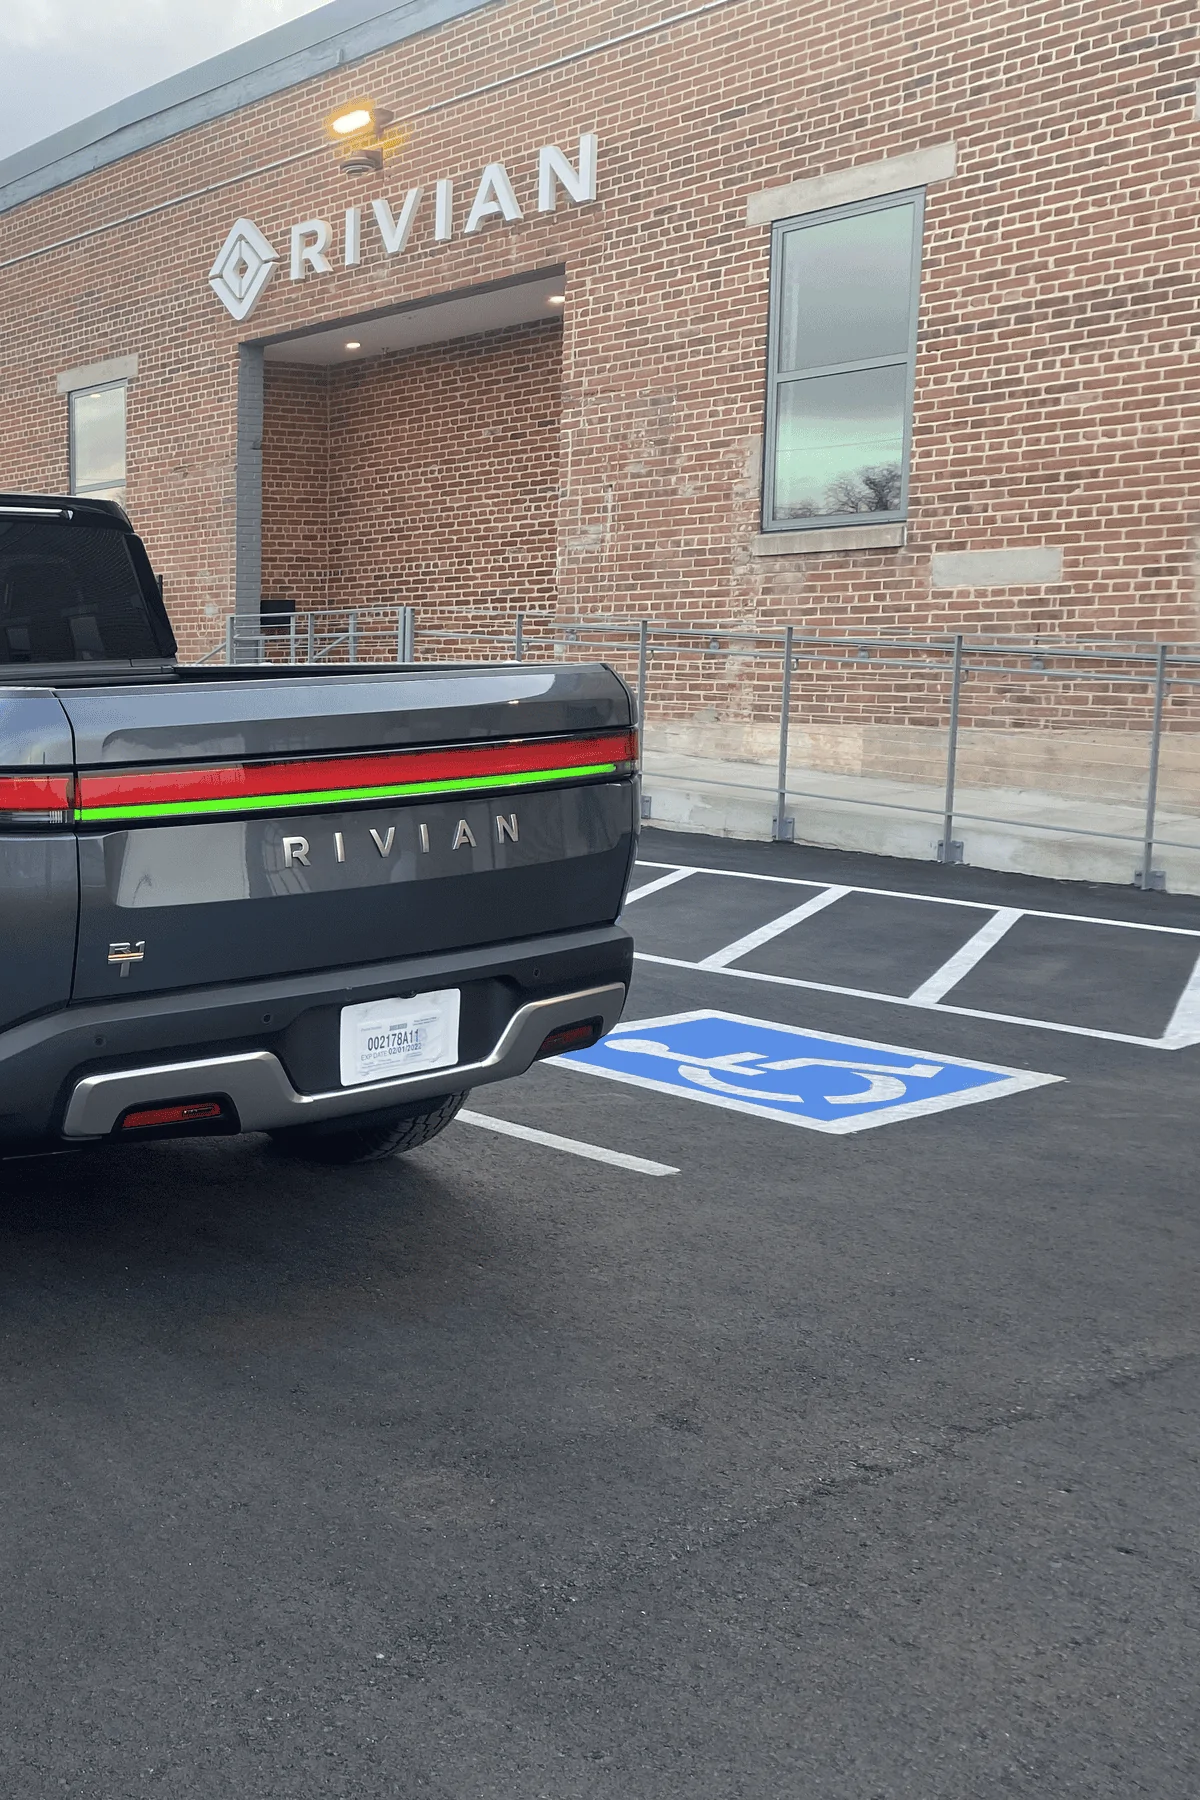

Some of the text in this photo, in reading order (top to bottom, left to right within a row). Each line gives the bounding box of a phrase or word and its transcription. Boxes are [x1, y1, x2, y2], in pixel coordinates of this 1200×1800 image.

[290, 133, 599, 281] RIVIAN
[282, 813, 519, 868] RIVIAN
[367, 1028, 420, 1051] 002178A11
[388, 1043, 422, 1056] 02/01/2022
